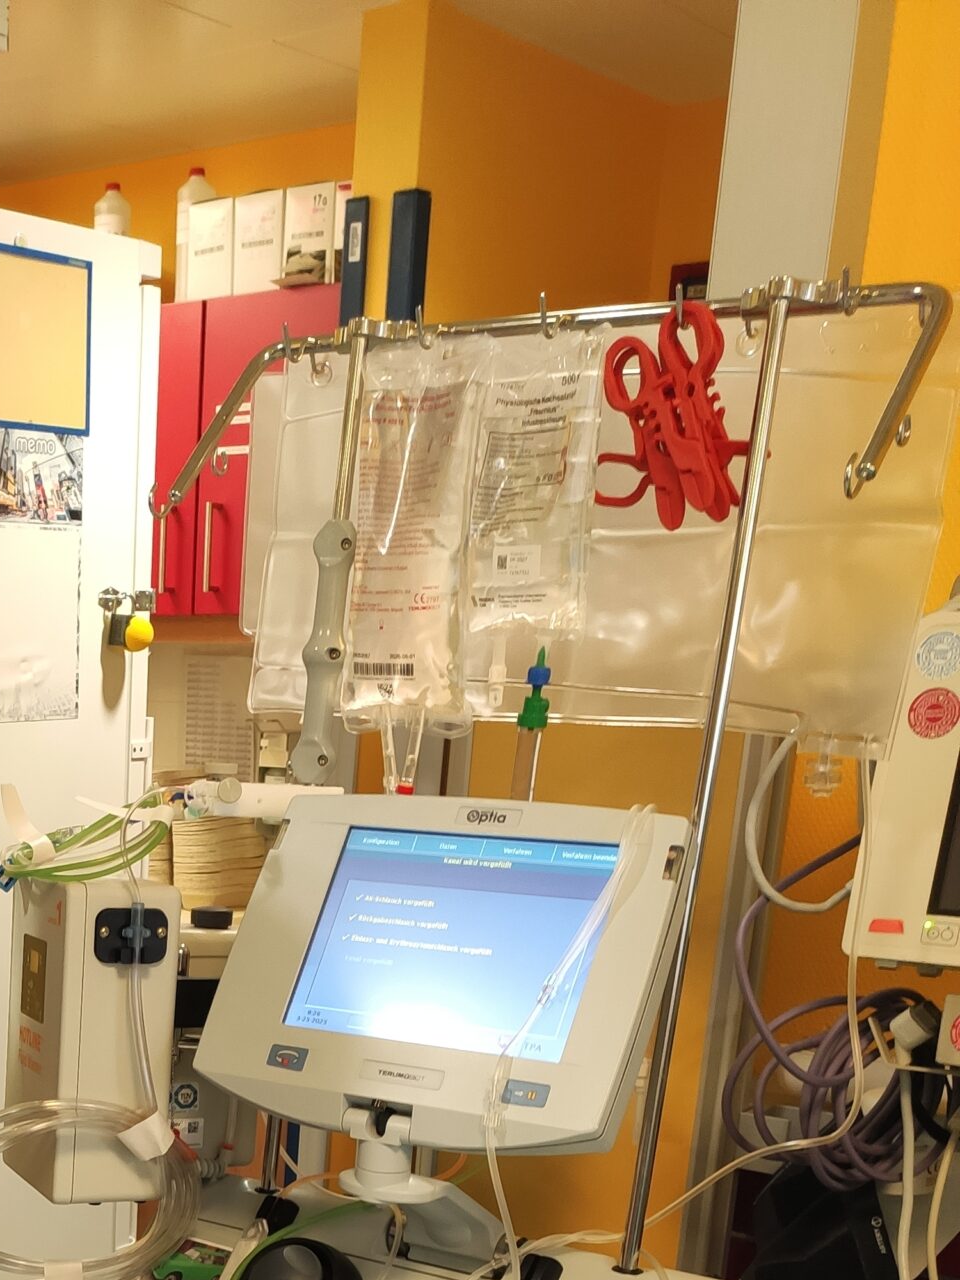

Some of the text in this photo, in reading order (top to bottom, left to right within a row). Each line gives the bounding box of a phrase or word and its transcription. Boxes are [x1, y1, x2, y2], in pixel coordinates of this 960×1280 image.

[15, 436, 56, 456] memo
[503, 847, 532, 856] Verfahren
[562, 851, 592, 861] Verfahren
